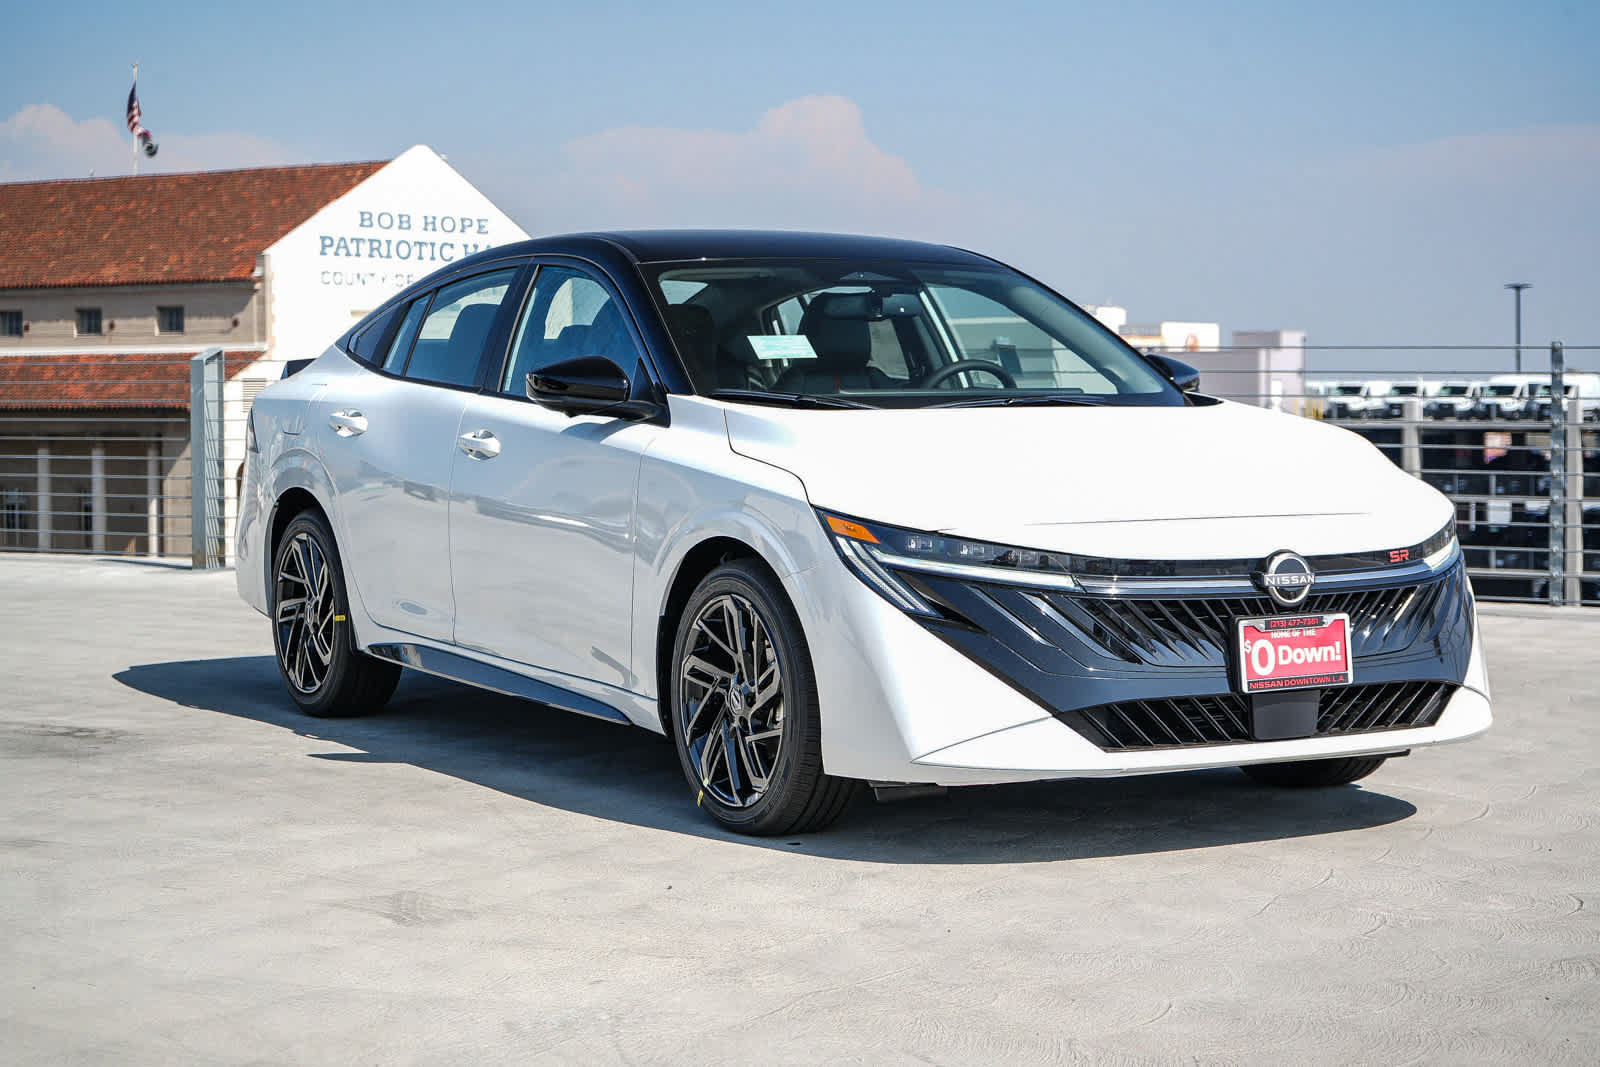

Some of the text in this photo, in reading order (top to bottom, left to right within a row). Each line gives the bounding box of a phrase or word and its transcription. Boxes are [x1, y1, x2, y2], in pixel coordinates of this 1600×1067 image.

[359, 210, 489, 235] BOB HOPE
[319, 235, 455, 262] PATRIOTIC
[1389, 549, 1410, 563] SR
[1264, 574, 1316, 587] NISSAN
[1271, 627, 1317, 639] HOME OF THE
[1278, 640, 1342, 665] Down!
[1249, 680, 1284, 690] NISSAN
[1284, 676, 1332, 686] DOWNTOWN
